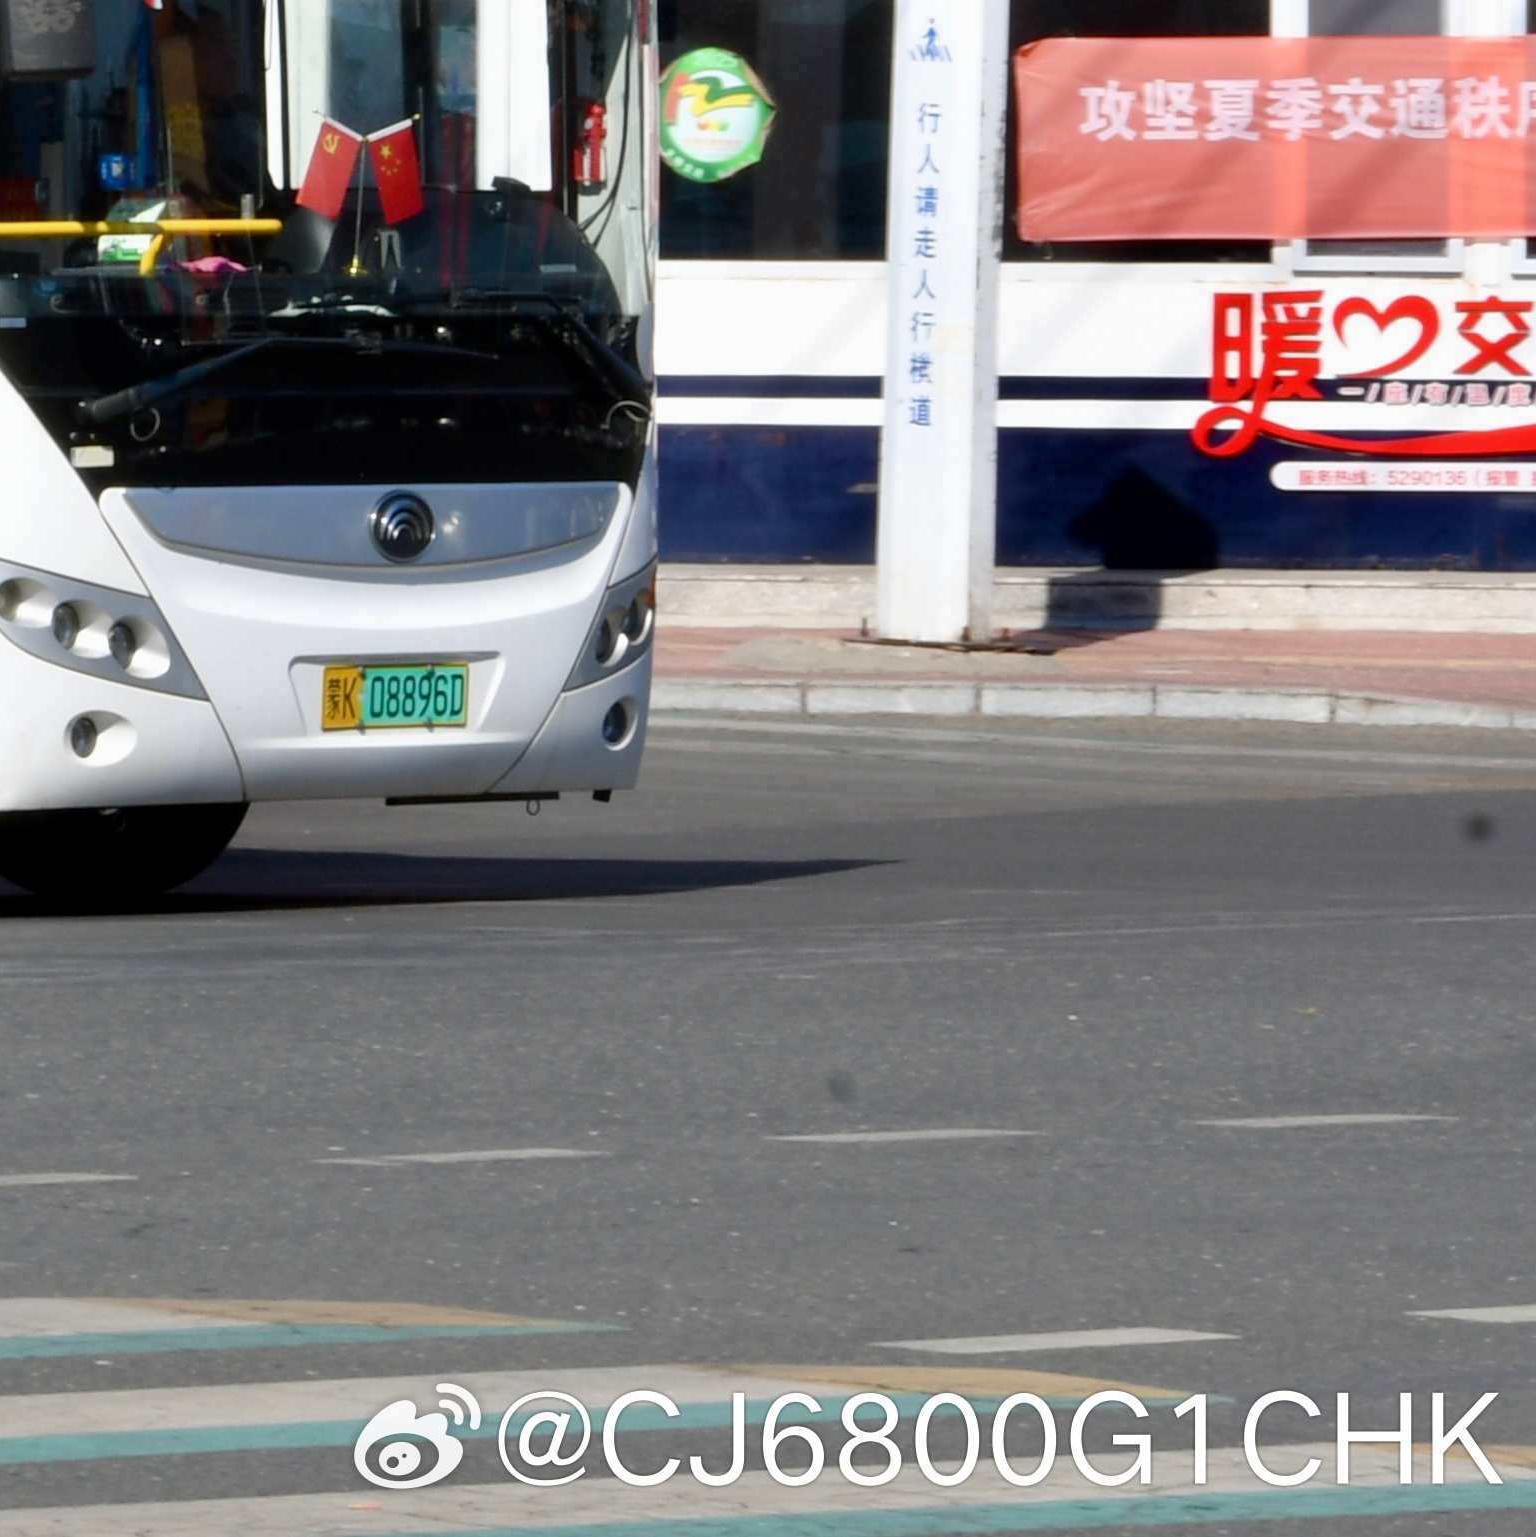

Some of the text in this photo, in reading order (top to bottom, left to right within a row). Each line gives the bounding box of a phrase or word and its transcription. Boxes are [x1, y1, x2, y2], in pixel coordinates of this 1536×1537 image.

[908, 102, 943, 427] 行人请走人行横道
